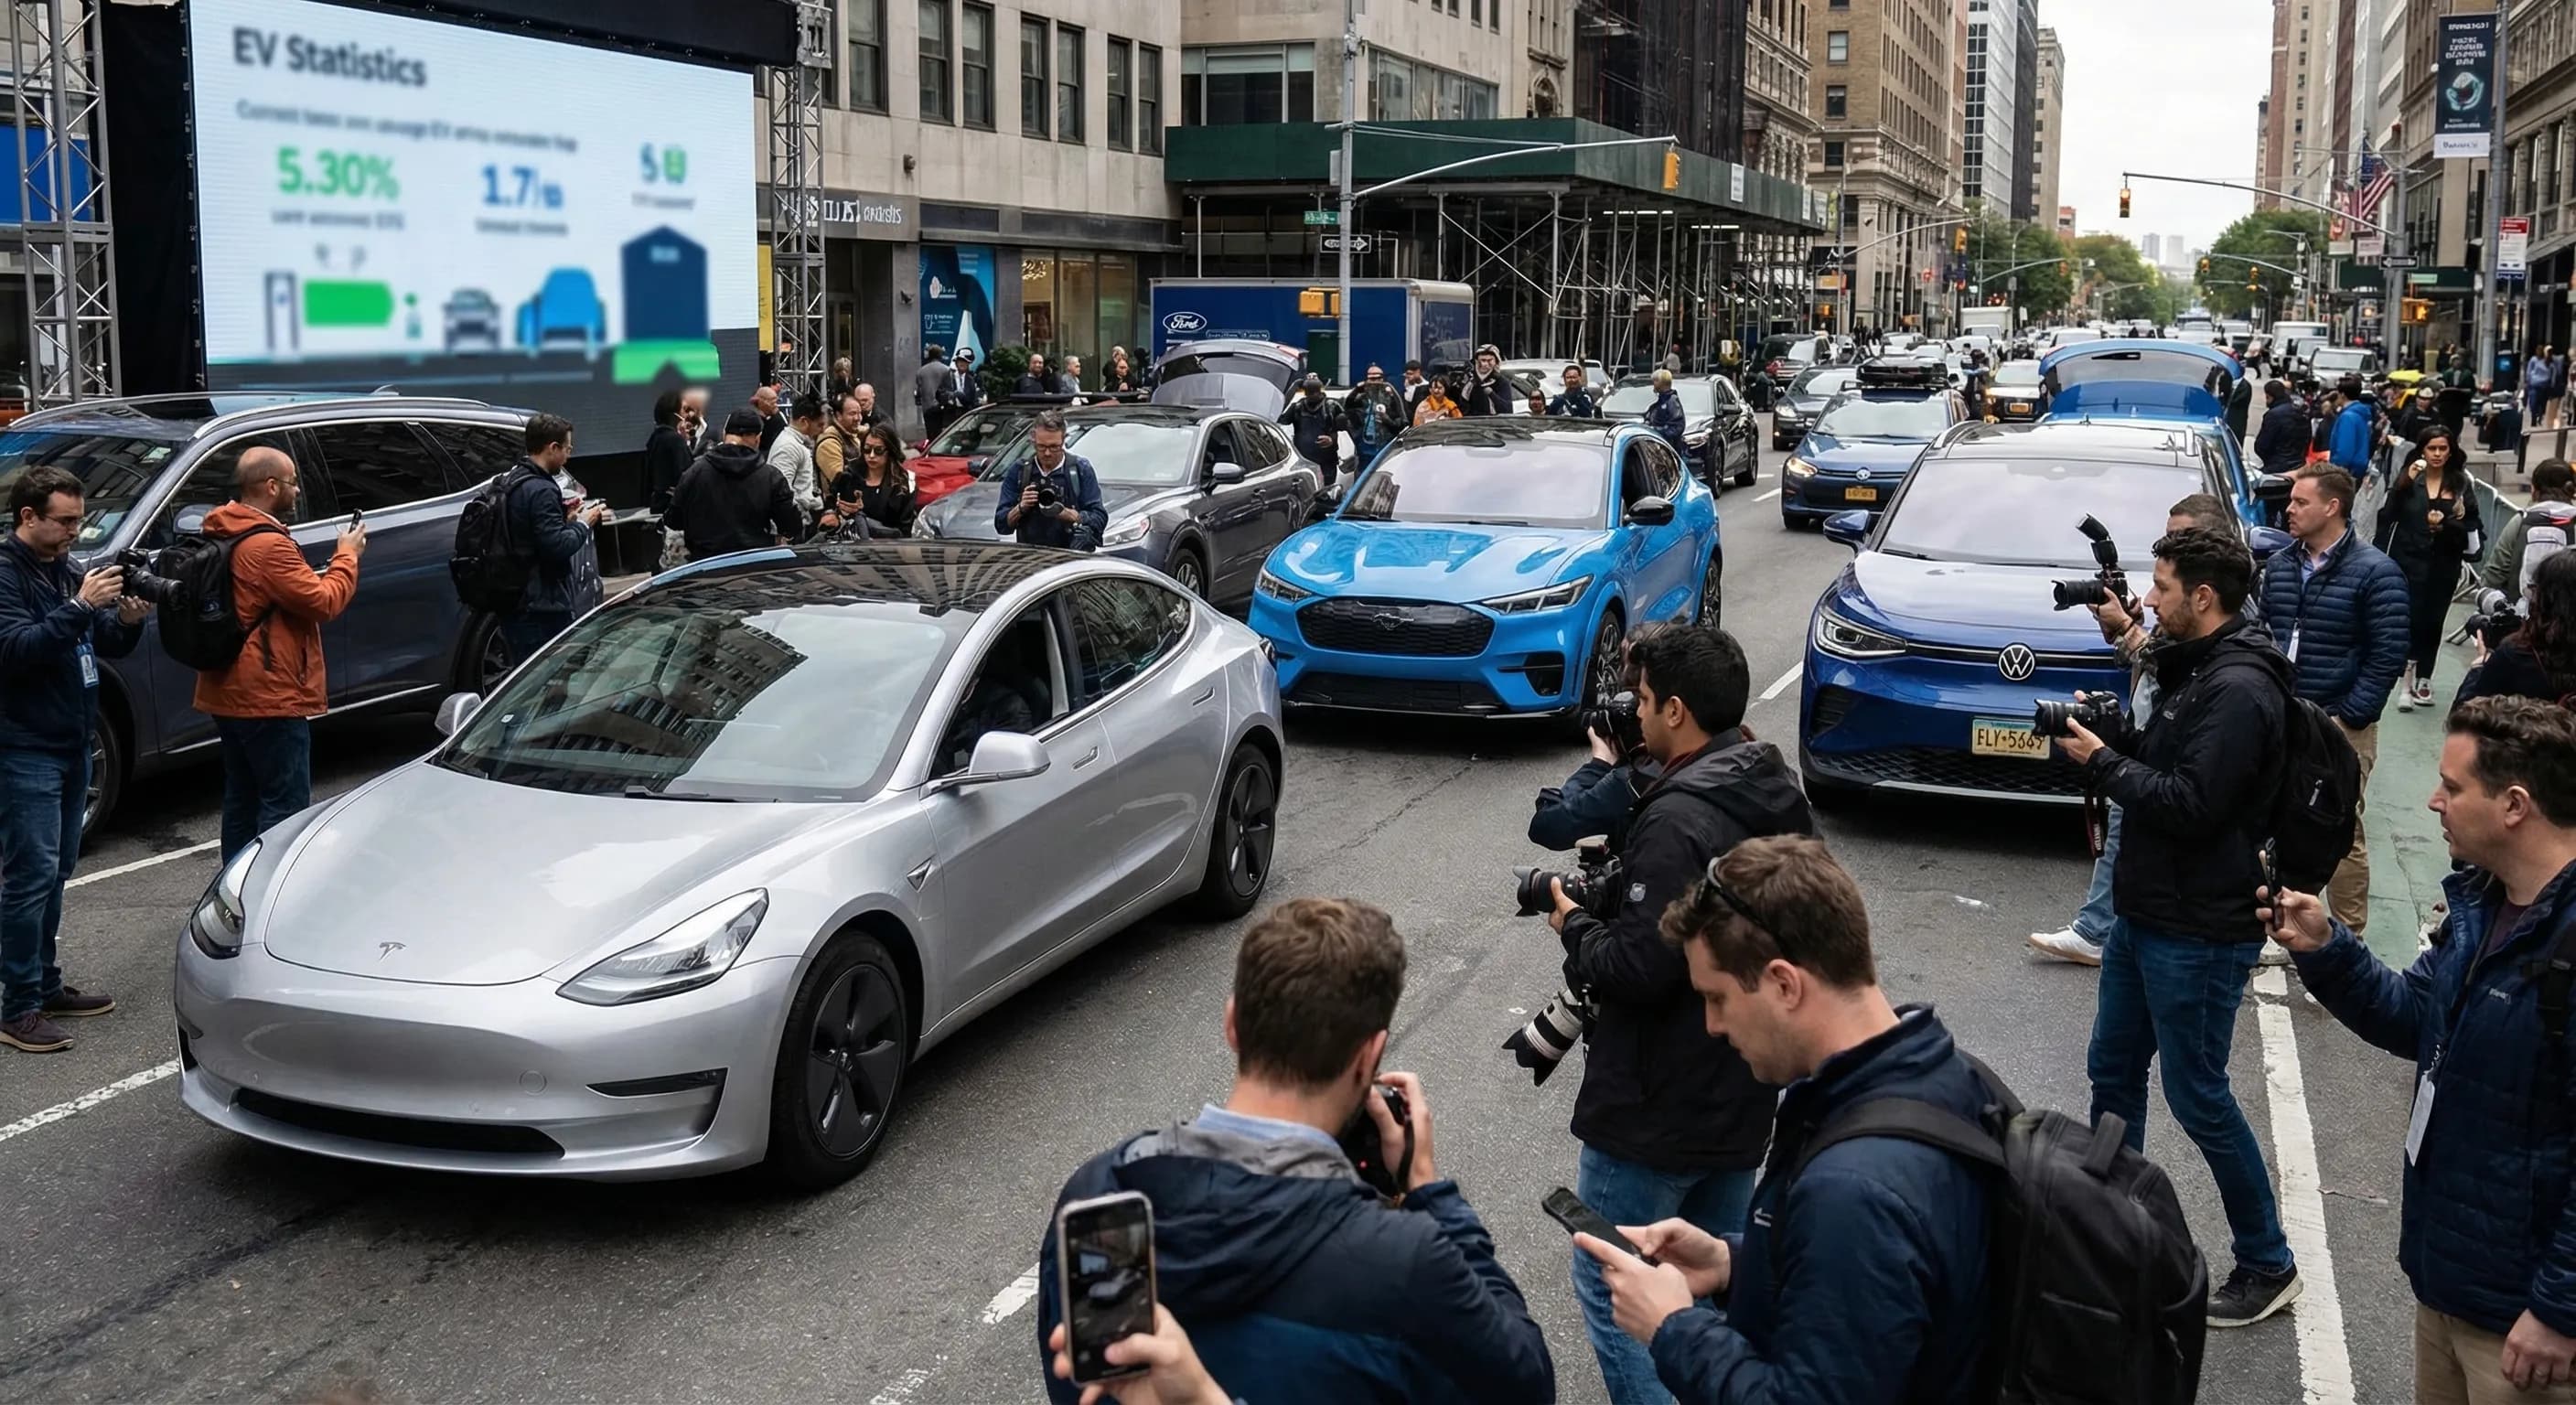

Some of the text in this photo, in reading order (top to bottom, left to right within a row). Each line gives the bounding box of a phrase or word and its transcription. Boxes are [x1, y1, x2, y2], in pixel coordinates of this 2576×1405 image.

[232, 26, 427, 87] EV Statistics
[276, 145, 402, 202] 5.30%
